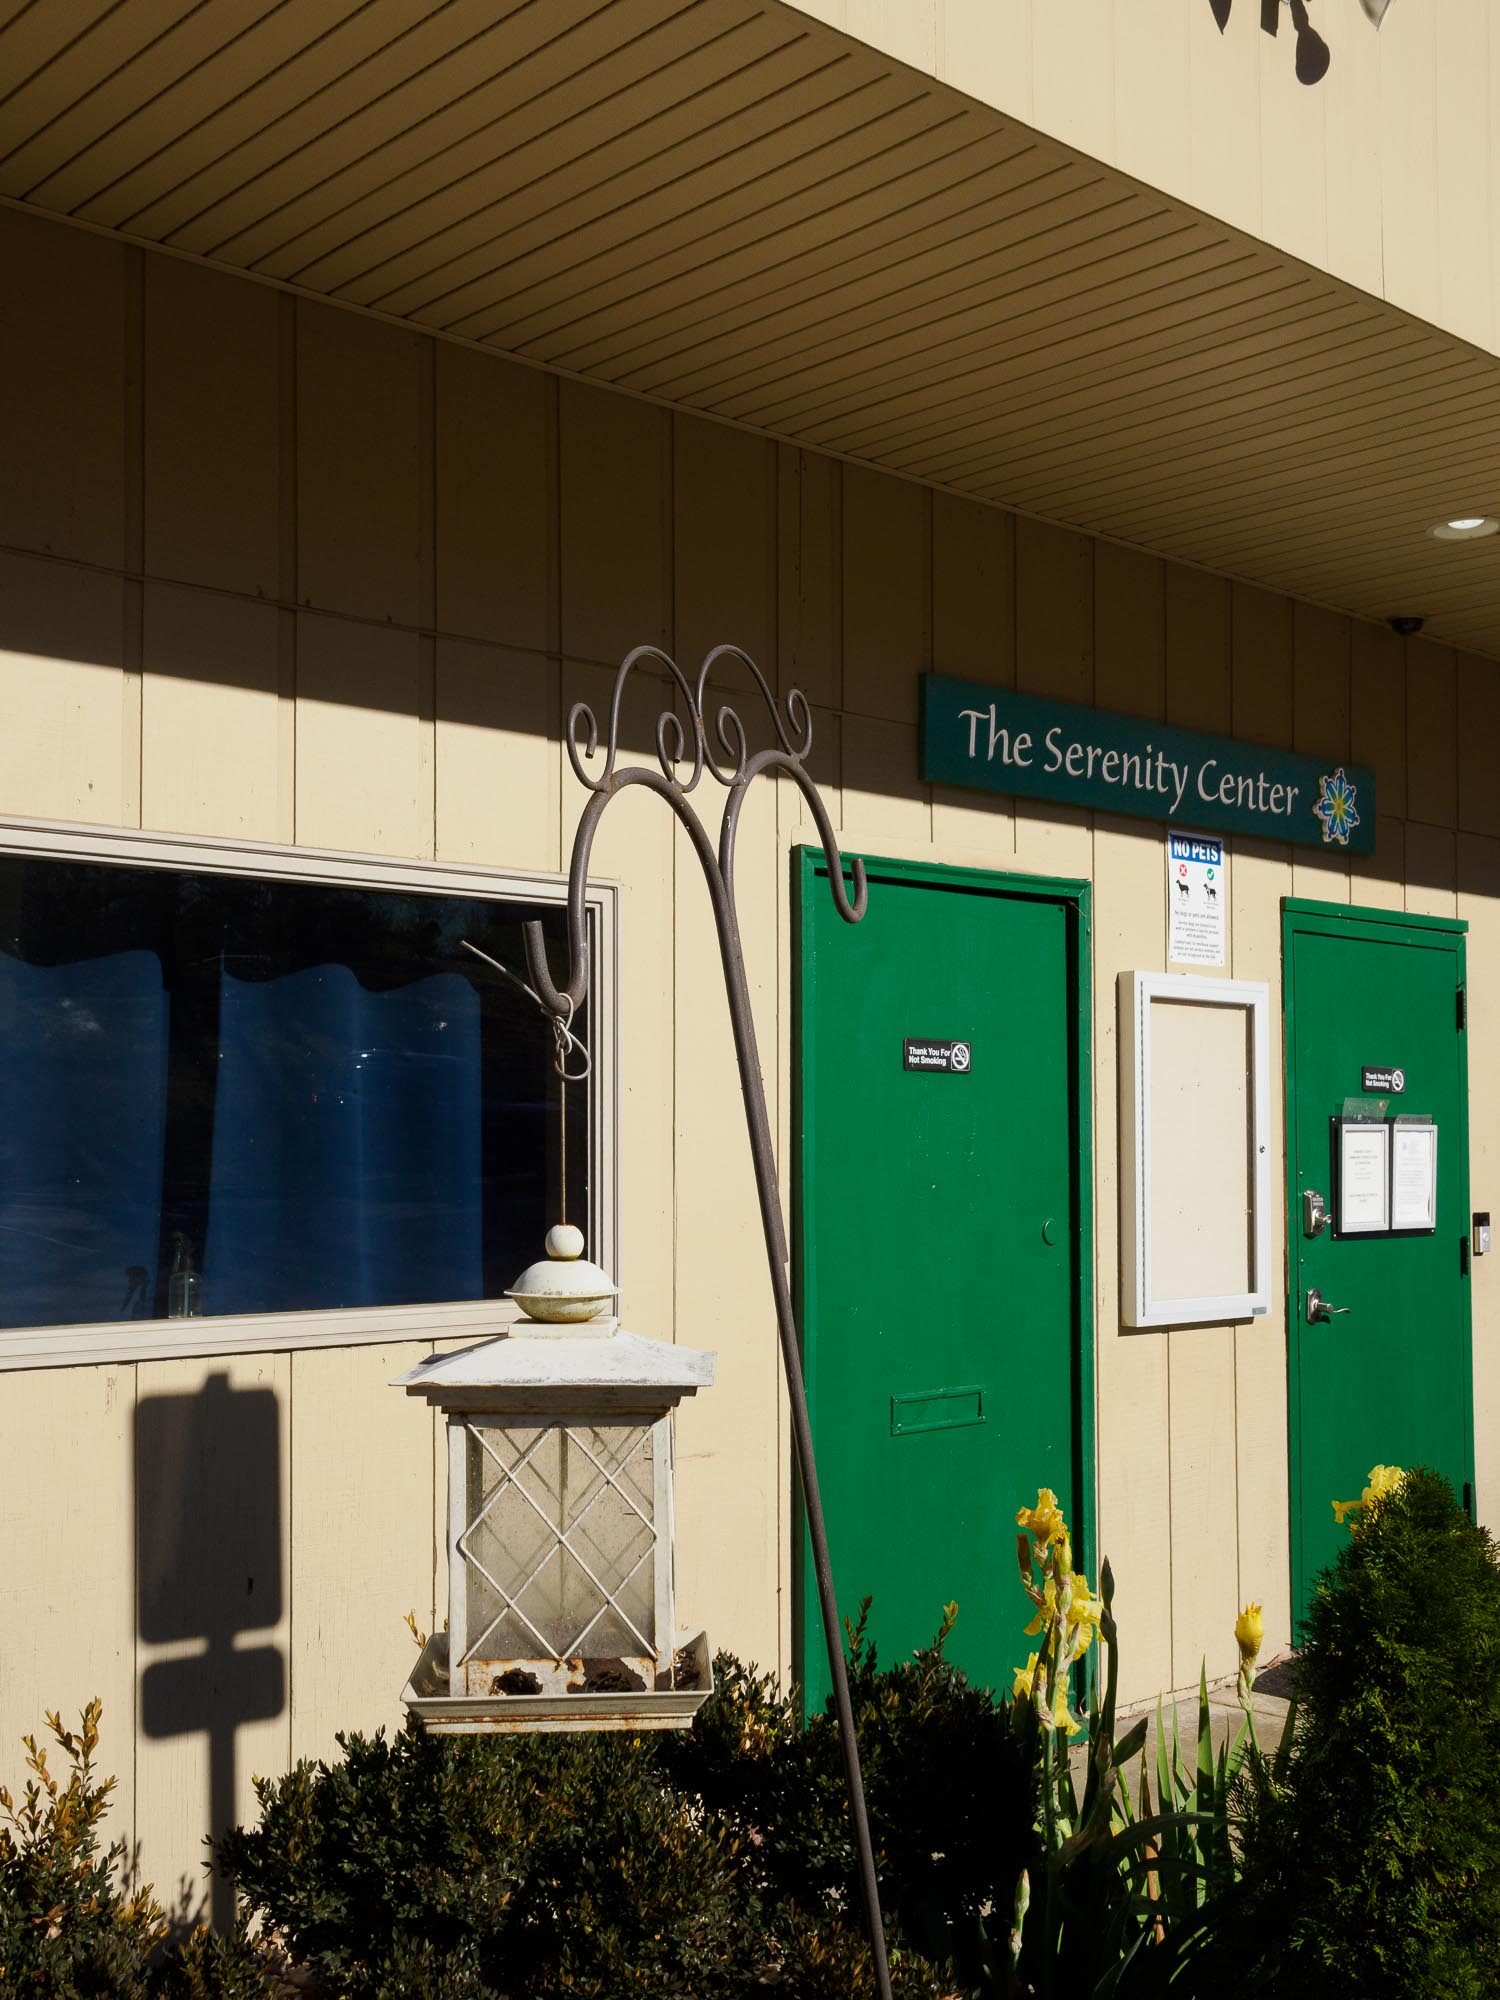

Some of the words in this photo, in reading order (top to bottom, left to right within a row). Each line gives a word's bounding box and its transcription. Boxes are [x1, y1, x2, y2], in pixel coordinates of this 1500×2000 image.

[958, 704, 1033, 767] The
[1044, 728, 1188, 815] Serenity
[1197, 759, 1299, 816] Center
[1173, 839, 1190, 858] NO
[1192, 842, 1219, 862] PETS
[909, 1046, 928, 1056] Thank
[928, 1047, 940, 1057] You
[940, 1048, 951, 1057] For
[908, 1055, 920, 1064] Not
[920, 1056, 947, 1067] Smoking
[1365, 1072, 1377, 1080] Thank
[1377, 1073, 1385, 1081] You
[1365, 1079, 1373, 1087] Not
[1372, 1080, 1390, 1089] Smoking
